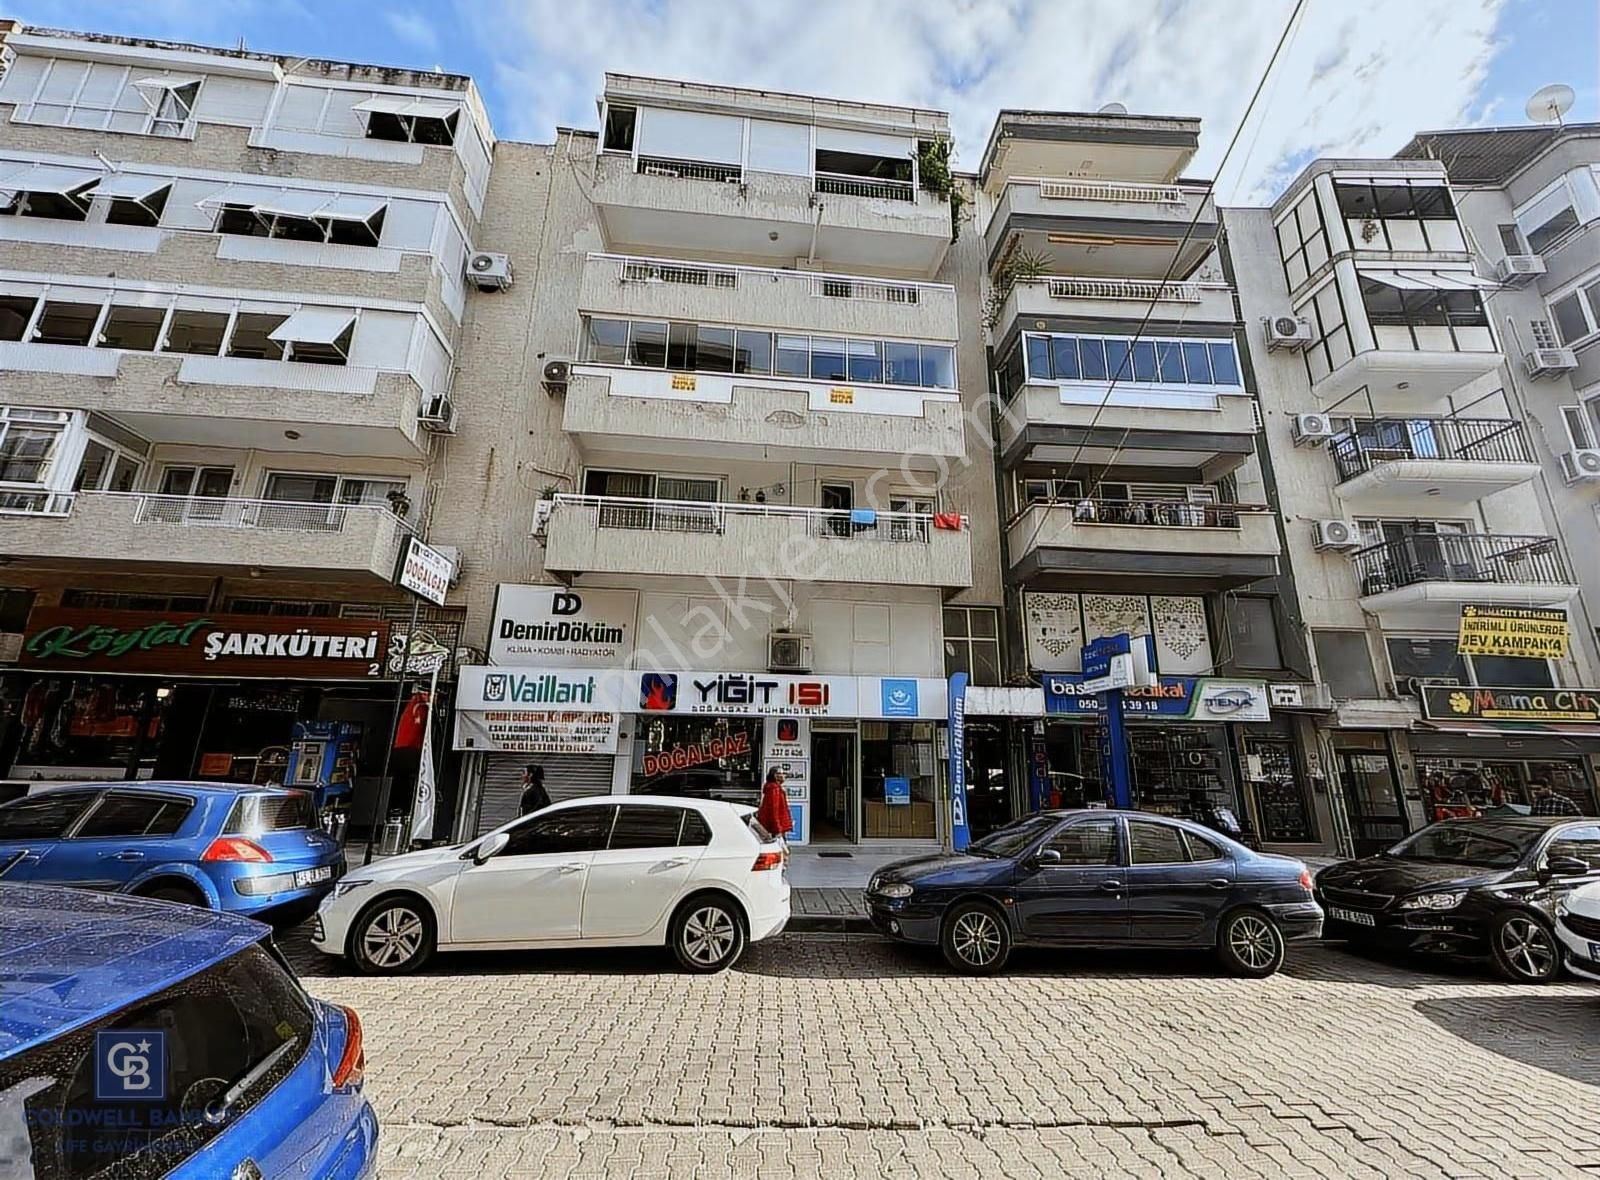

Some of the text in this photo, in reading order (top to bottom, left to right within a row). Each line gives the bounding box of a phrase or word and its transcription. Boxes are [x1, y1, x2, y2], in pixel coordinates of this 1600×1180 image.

[500, 618, 623, 643] DemirDöküm
[204, 629, 378, 660] ŞARKÜTERİ
[367, 663, 380, 675] 2
[509, 674, 597, 703] Vaillant
[693, 674, 829, 705] YİĞİT ISI
[1051, 678, 1097, 696] bas
[1122, 681, 1187, 698] edikal
[1474, 690, 1548, 714] Mama
[642, 731, 752, 777] DOĞALGAZ
